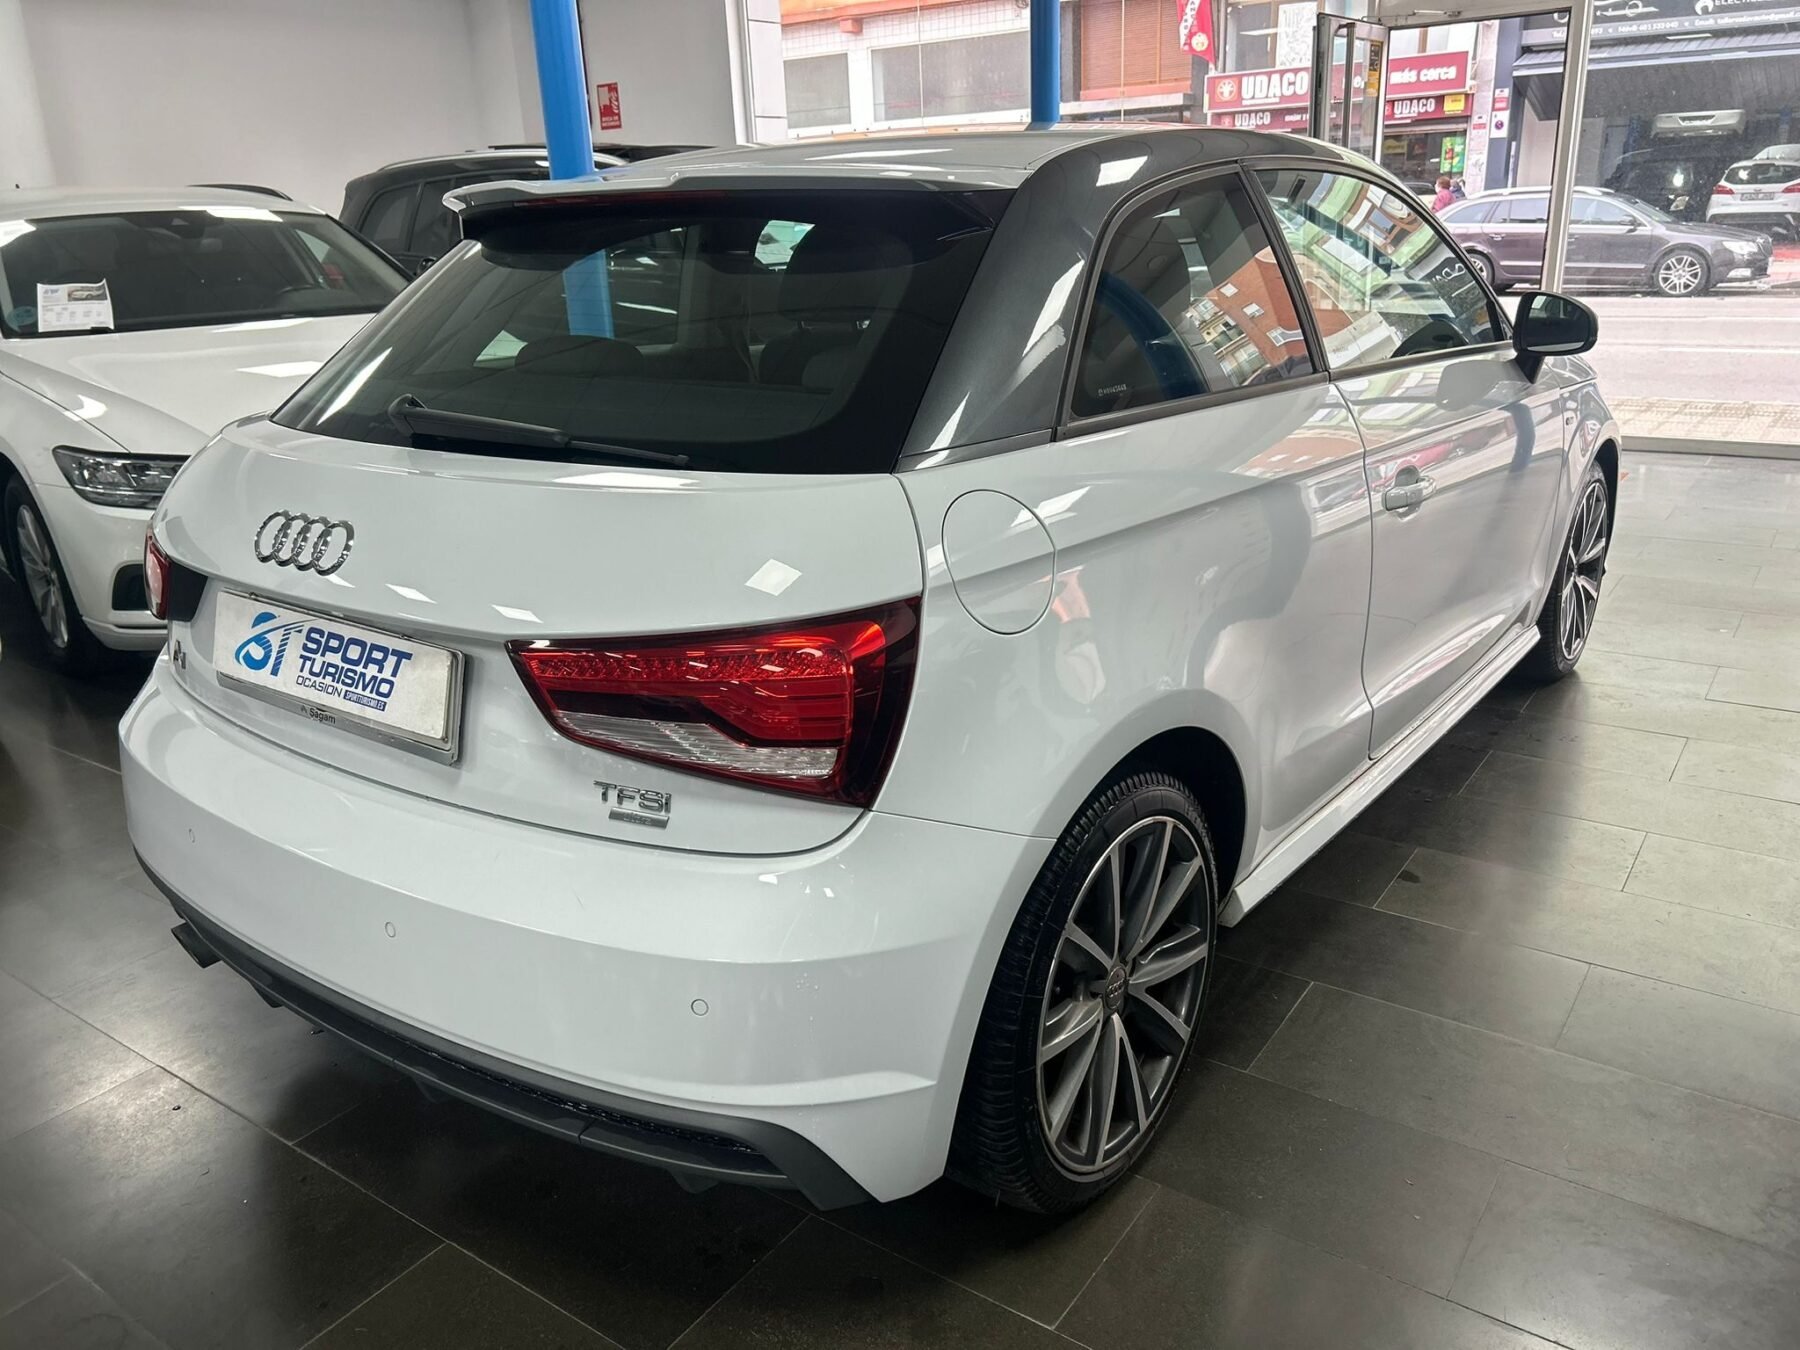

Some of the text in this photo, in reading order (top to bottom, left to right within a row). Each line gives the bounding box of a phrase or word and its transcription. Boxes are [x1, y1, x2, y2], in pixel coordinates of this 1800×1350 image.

[1241, 70, 1309, 99] UDACO
[1390, 65, 1457, 84] más cerca
[1394, 99, 1435, 114] UDACO
[1235, 111, 1271, 126] UDACO
[302, 626, 413, 679] SPORT
[295, 675, 343, 698] OCASION
[298, 653, 396, 699] TURISMO
[309, 707, 336, 725] Sagam
[593, 780, 672, 814] TFSI
